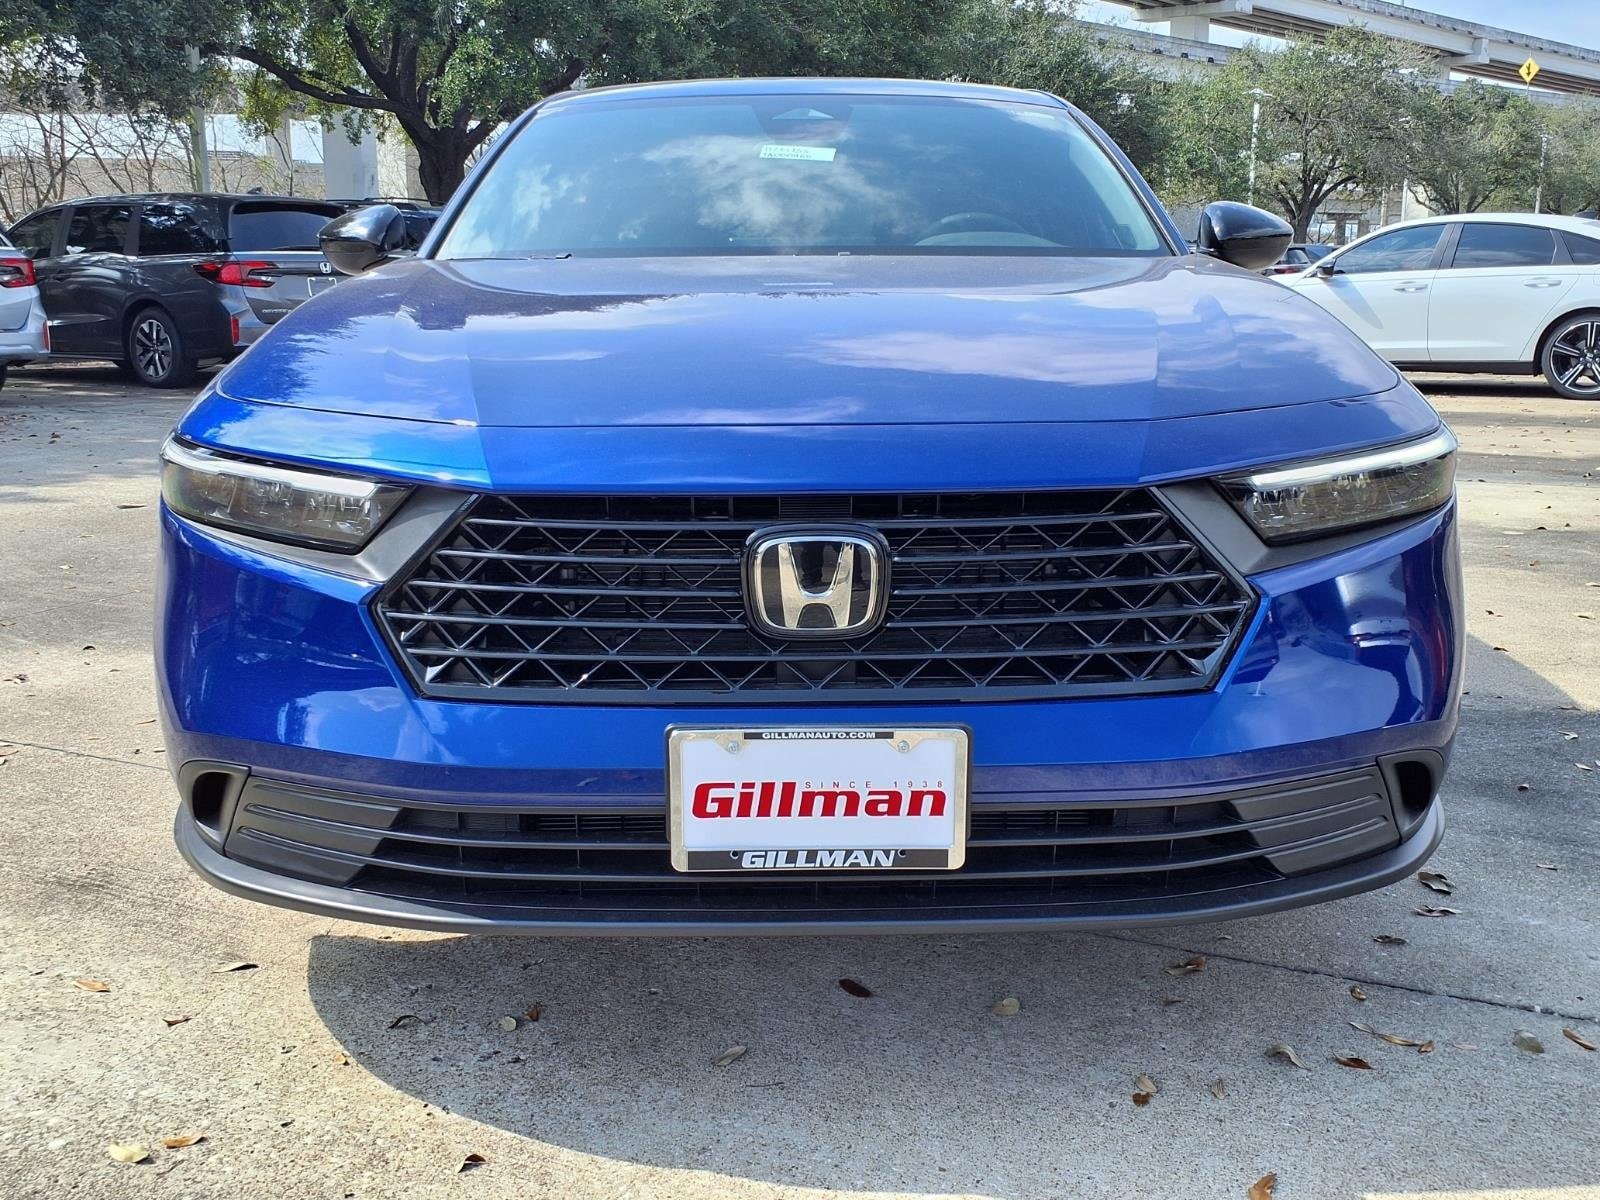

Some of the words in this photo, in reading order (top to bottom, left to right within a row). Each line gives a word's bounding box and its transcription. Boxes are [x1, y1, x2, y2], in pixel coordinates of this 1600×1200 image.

[762, 731, 876, 740] GILLMANAUTO.COM
[804, 781, 872, 789] SINCE
[893, 780, 943, 789] 1938
[692, 781, 947, 819] Gillman
[741, 850, 896, 869] GILLMAN
